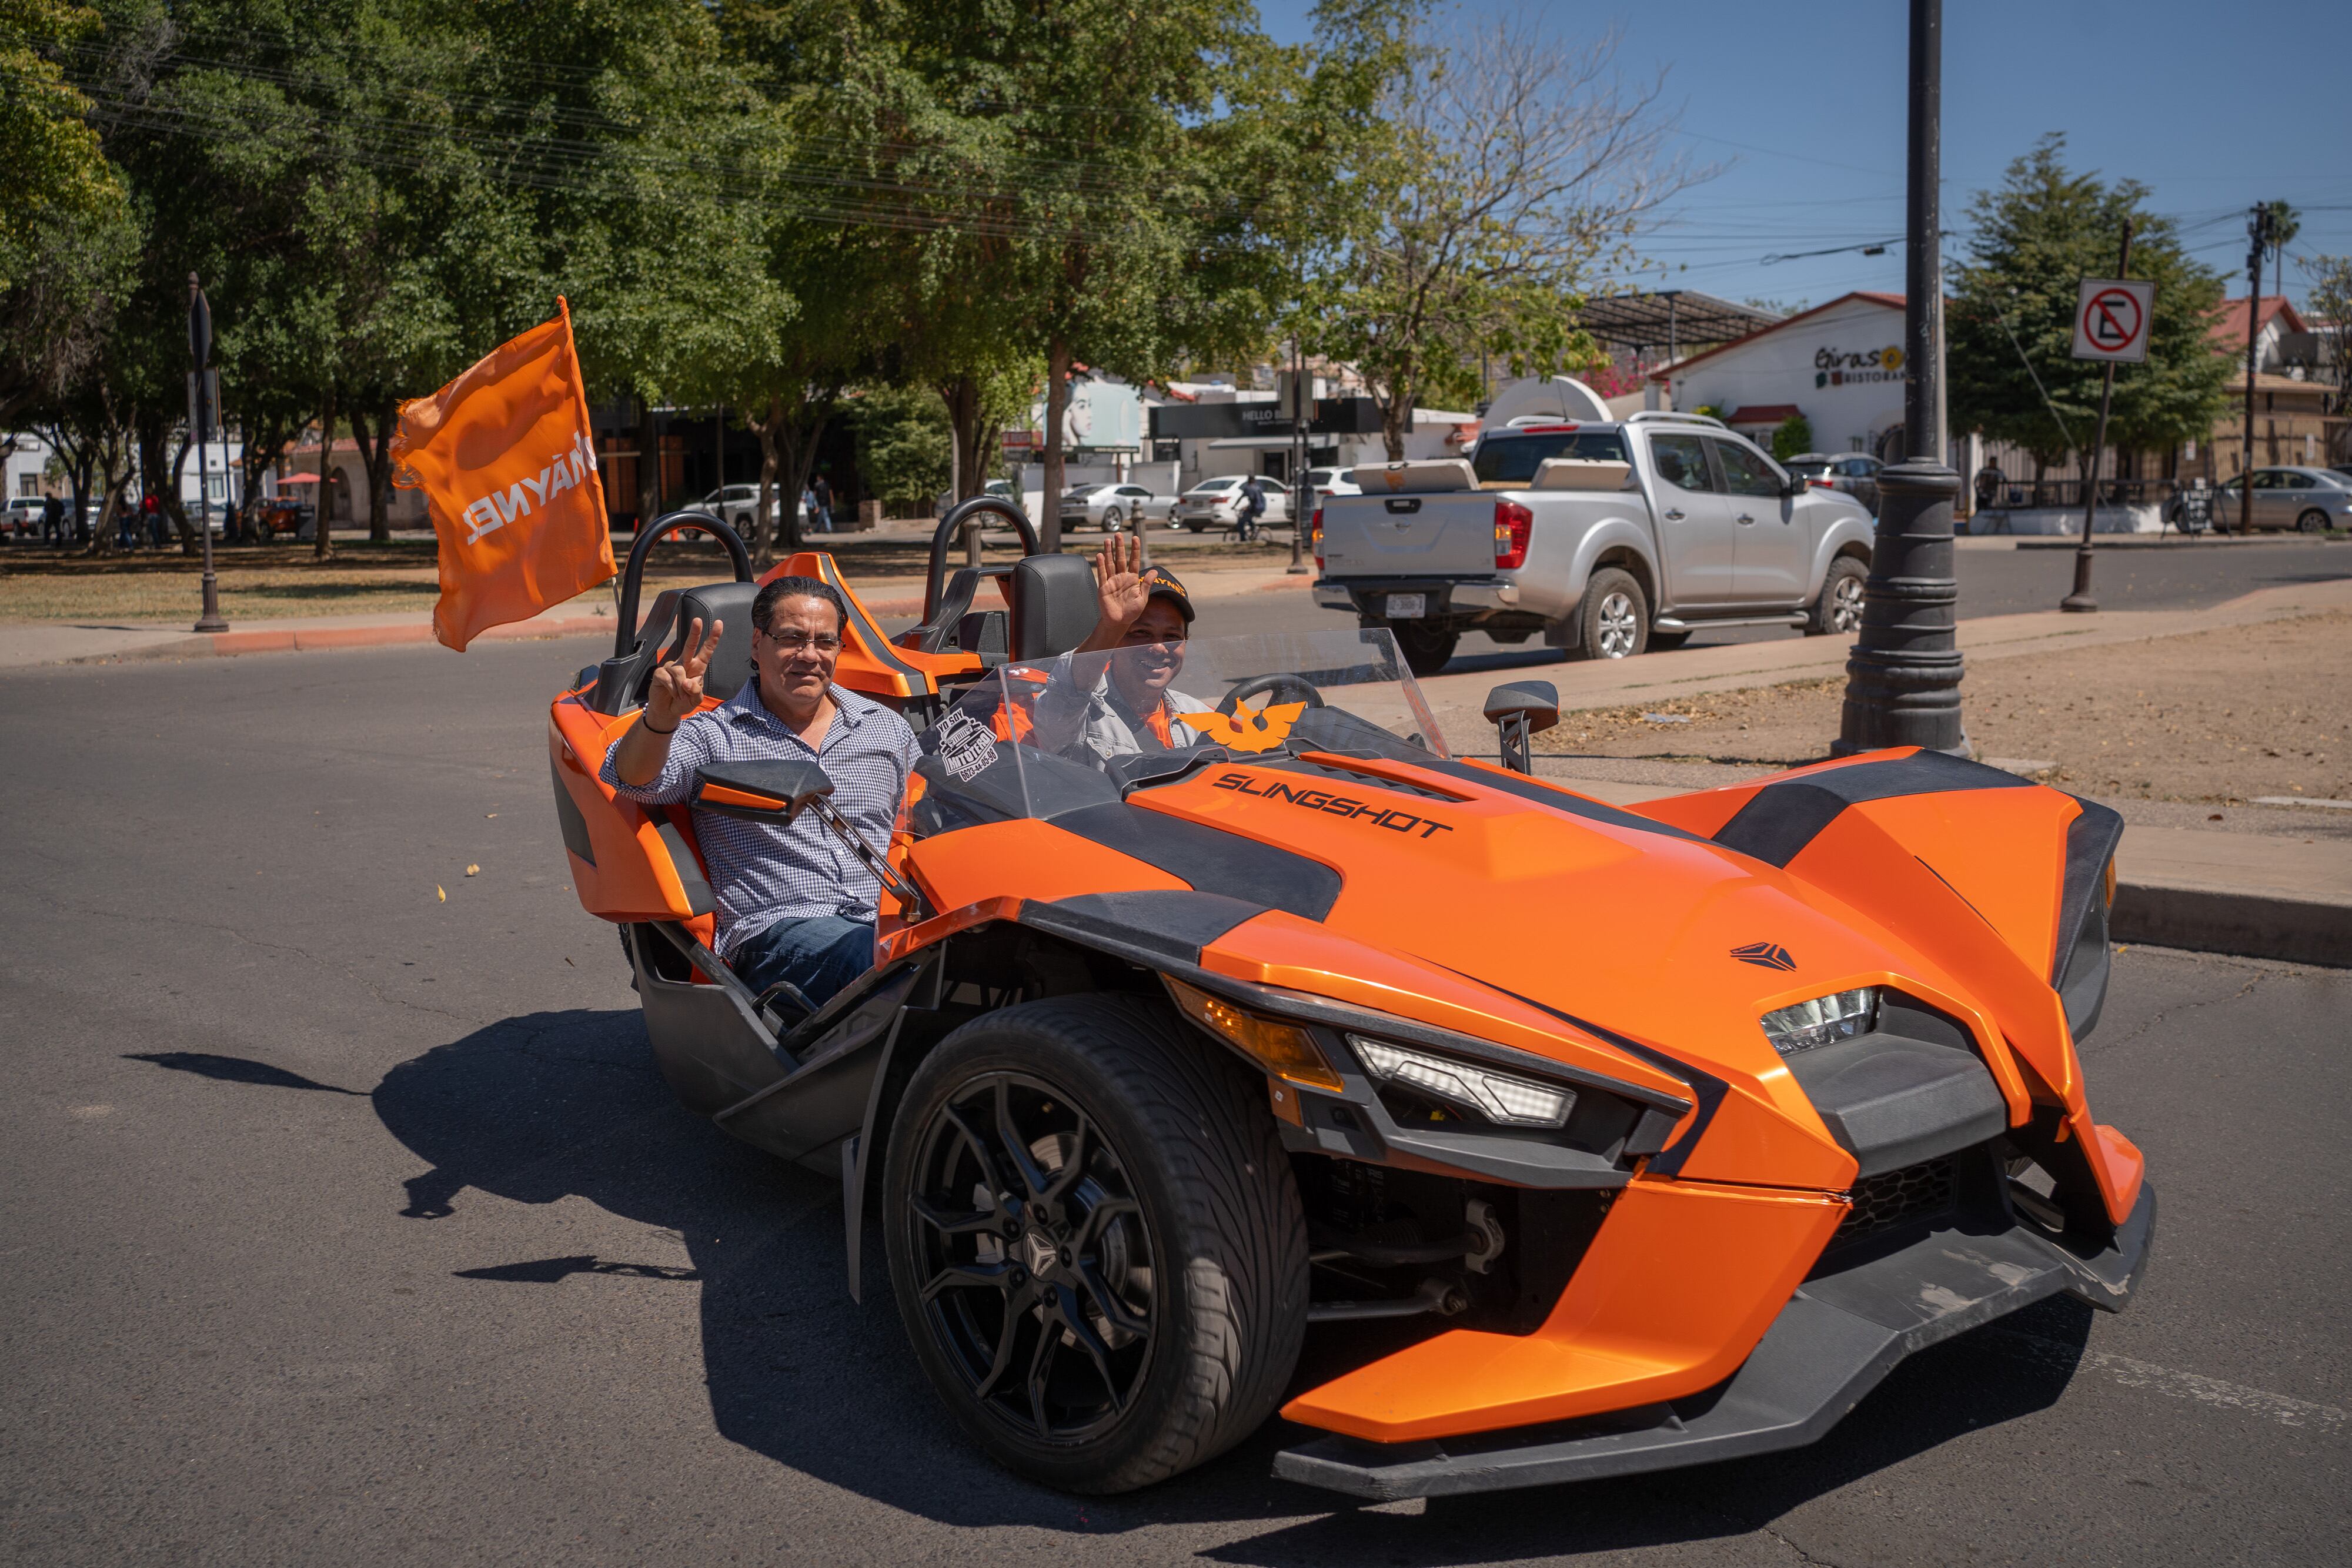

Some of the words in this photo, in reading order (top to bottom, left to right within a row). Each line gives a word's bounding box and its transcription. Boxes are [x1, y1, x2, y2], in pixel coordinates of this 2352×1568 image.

[2098, 300, 2126, 339] E
[1242, 409, 1273, 421] HELLO
[938, 723, 948, 733] YO
[949, 710, 963, 725] SOY
[947, 733, 991, 771] MITOTERO
[960, 748, 997, 781] 6623-44-05-98
[1212, 773, 1454, 838] SLINGSHOT
